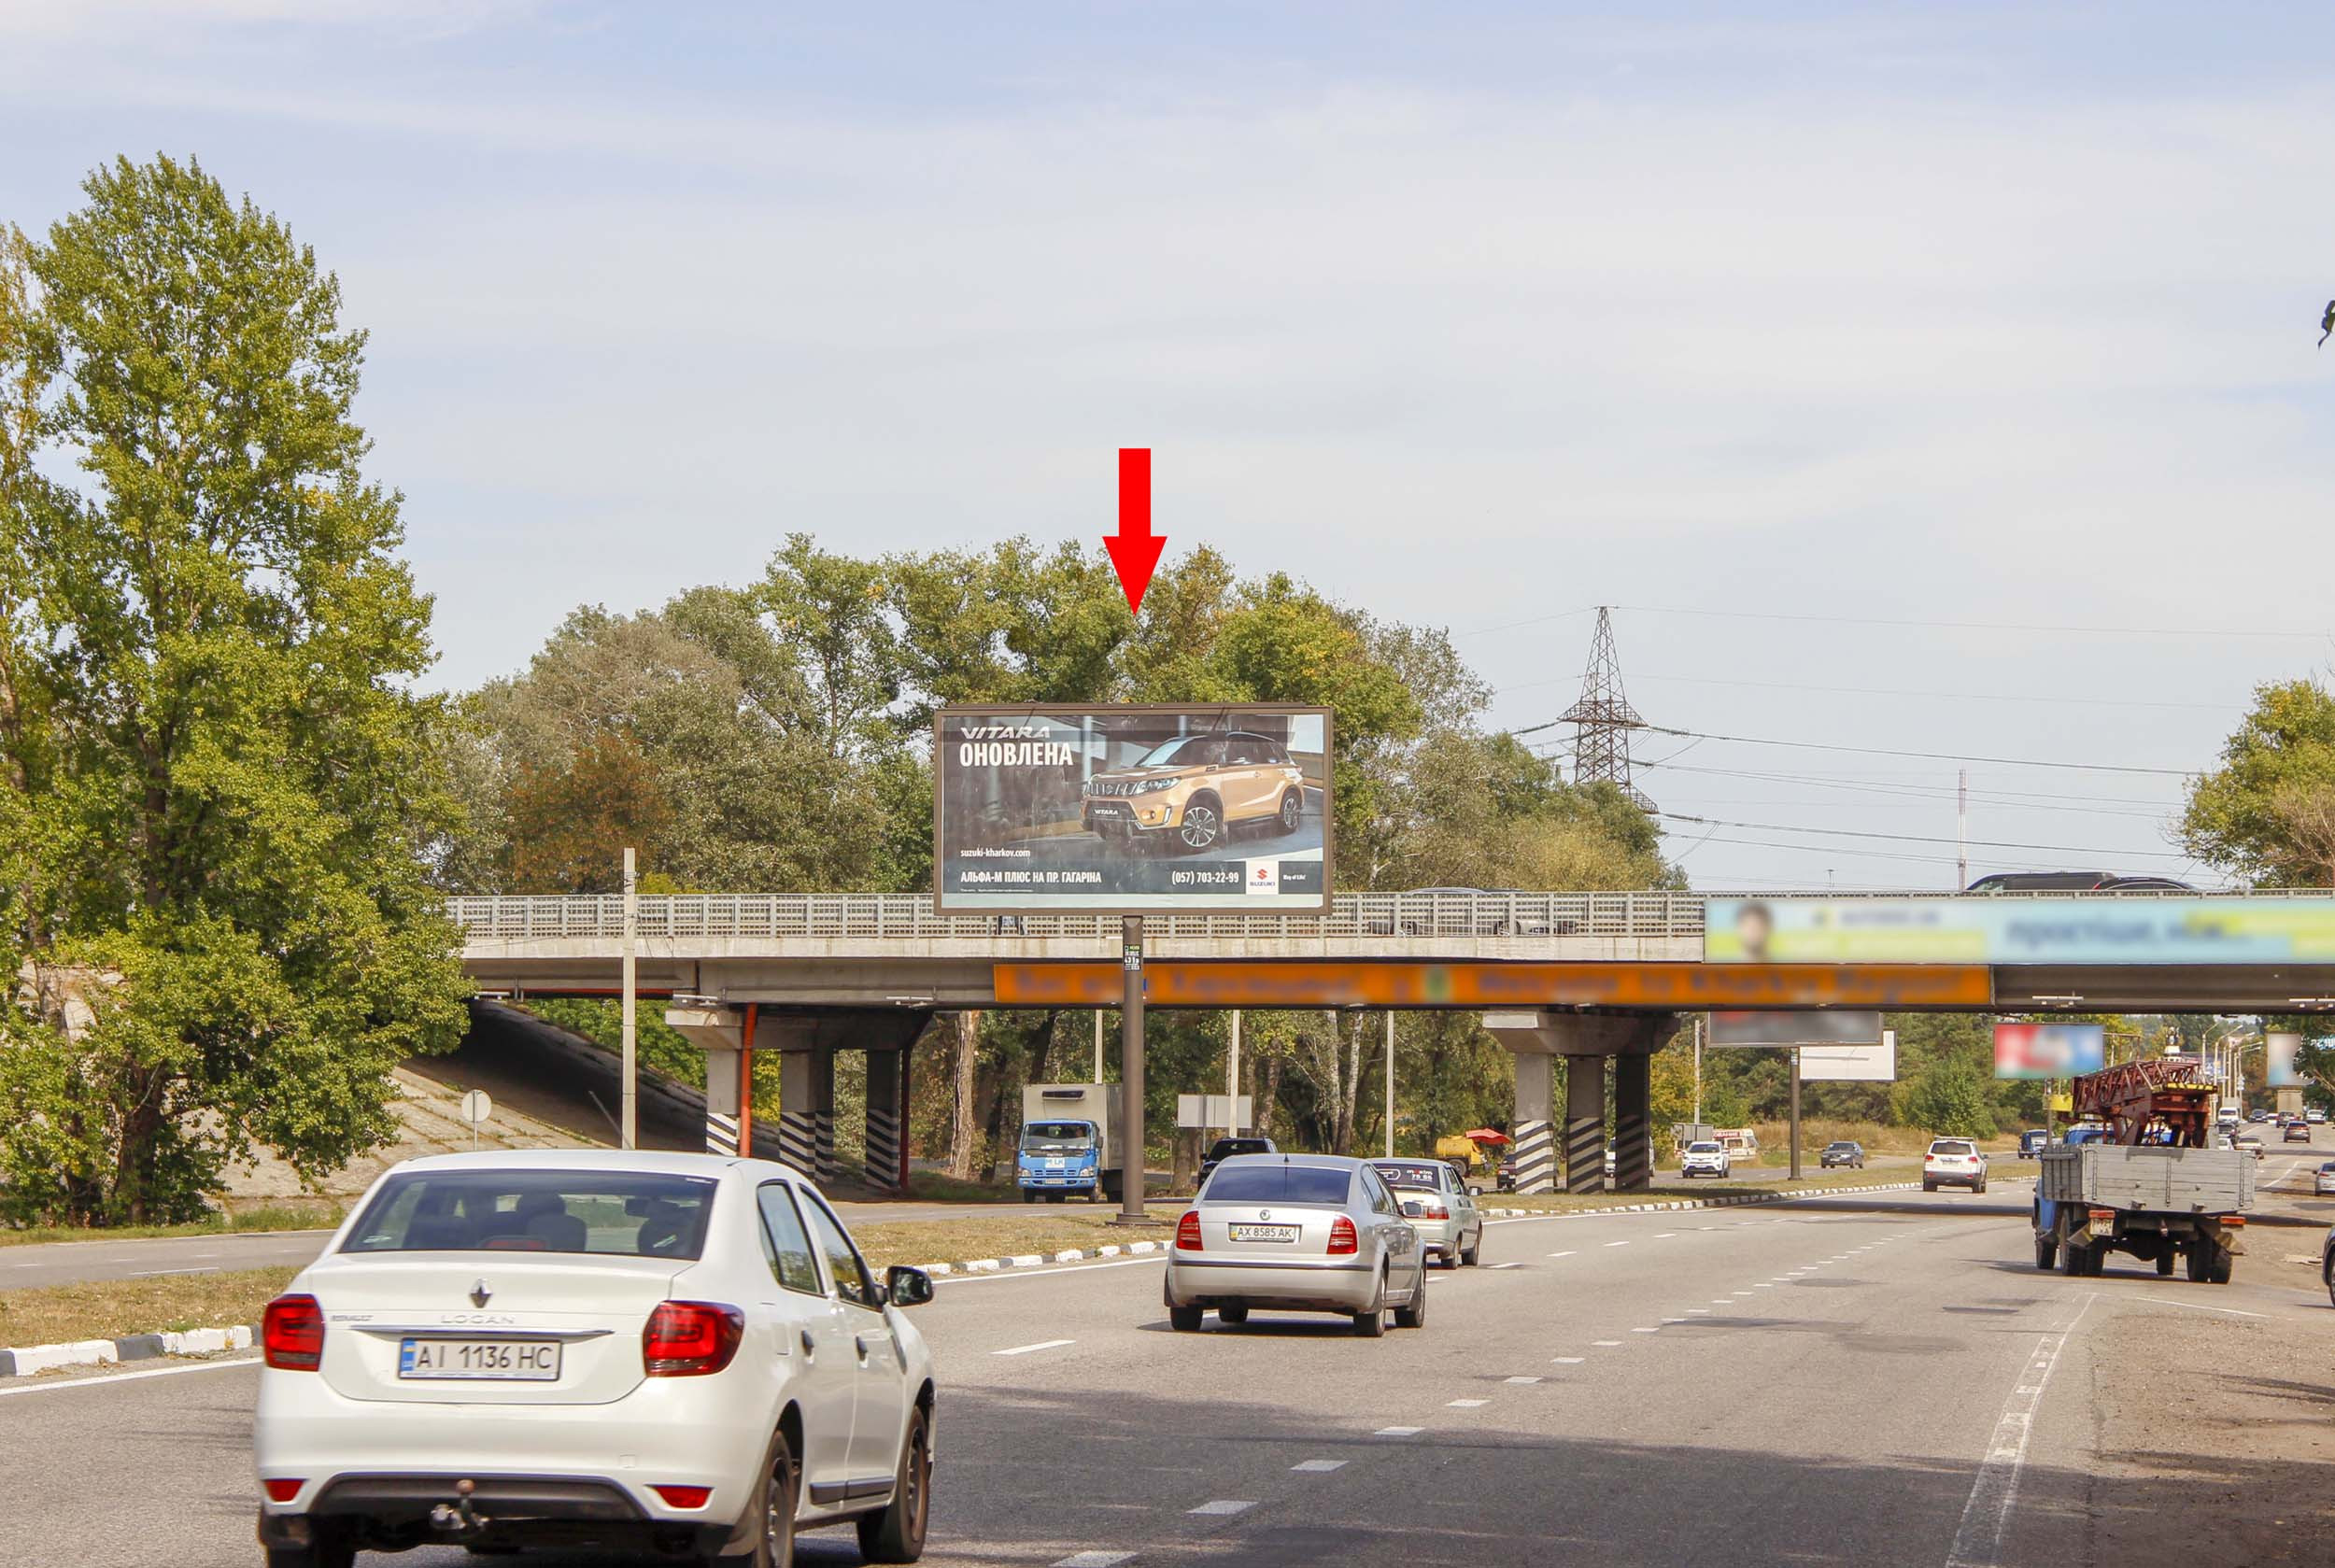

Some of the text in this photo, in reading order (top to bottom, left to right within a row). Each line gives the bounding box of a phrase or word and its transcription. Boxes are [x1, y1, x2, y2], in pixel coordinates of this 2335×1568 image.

[960, 726, 1050, 740] VITARA
[959, 742, 1074, 767] ОНОВЛЕНА
[960, 847, 1031, 858] suzuki-kharkov.com
[960, 871, 1102, 883] АЛЬФА-М ПЛЮС НА ПР. ГАГАРІНА
[1172, 870, 1238, 884] (057) 703-22-99
[1238, 1227, 1293, 1237] AX 8585 AK
[440, 1314, 516, 1324] LOGAN
[417, 1346, 553, 1369] AI 1136 HC
